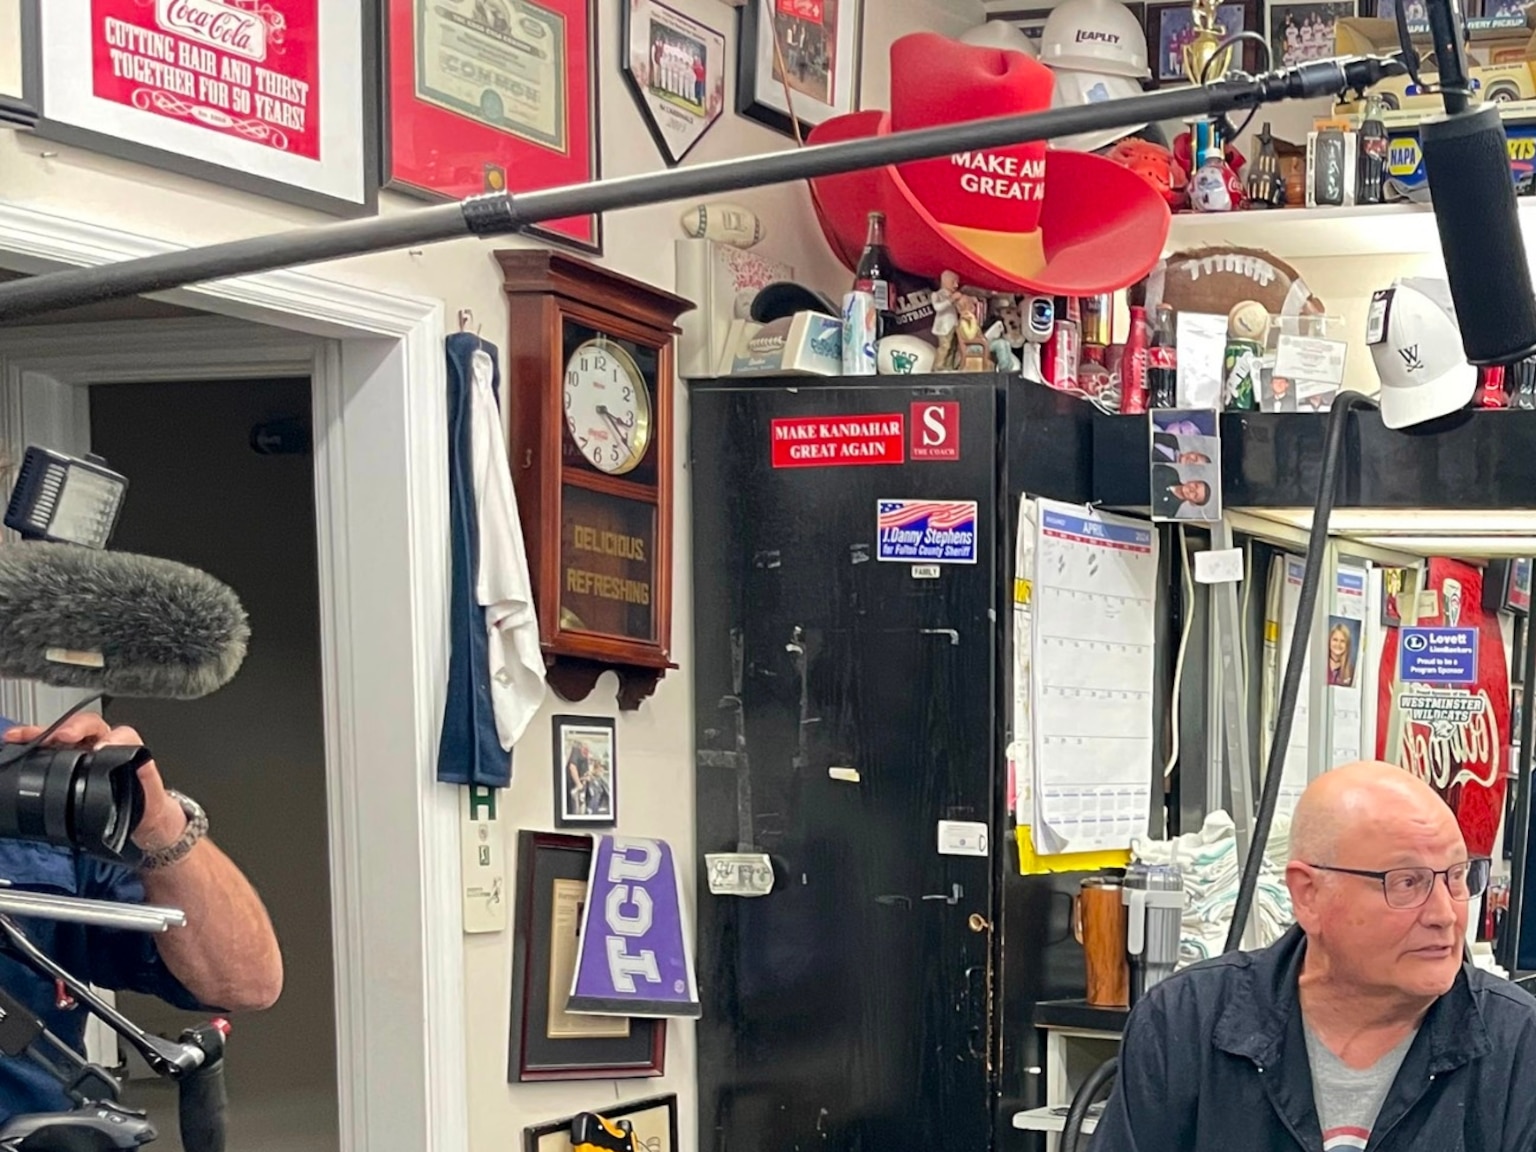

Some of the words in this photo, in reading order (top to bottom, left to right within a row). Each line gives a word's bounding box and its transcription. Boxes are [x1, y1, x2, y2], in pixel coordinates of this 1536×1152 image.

[1075, 29, 1120, 44] LEAPLEY
[105, 16, 174, 63] CUTTING
[178, 41, 217, 76] HAIR
[221, 56, 251, 88] AND
[255, 66, 309, 106] THIRST
[110, 48, 195, 98] TOGETHER
[199, 76, 229, 109] FOR
[232, 88, 250, 115] 50
[254, 92, 305, 133] YEARS!
[951, 152, 1018, 177] MAKE
[1391, 148, 1416, 166] NAPA
[960, 174, 1032, 201] GREAT
[775, 424, 817, 441] MAKE
[819, 421, 901, 439] KANDAHAR
[922, 405, 946, 446] S
[789, 444, 838, 459] GREAT
[840, 442, 886, 457] AGAIN
[929, 448, 956, 456] COACH
[924, 527, 973, 547] Stephens
[1082, 521, 1105, 537] APRIL
[882, 544, 894, 555] for
[895, 544, 917, 555] Fulton
[918, 544, 943, 558] County
[944, 545, 971, 557] Sheriff
[567, 567, 649, 606] REFRESHING
[1429, 633, 1467, 645] Lovett
[1416, 657, 1436, 665] Proud
[1410, 666, 1437, 675] Program
[1438, 666, 1465, 675] Sponsor
[1401, 696, 1482, 711] WESTMINSTER
[1413, 709, 1469, 721] WILDCATS
[606, 836, 662, 993] TCU
